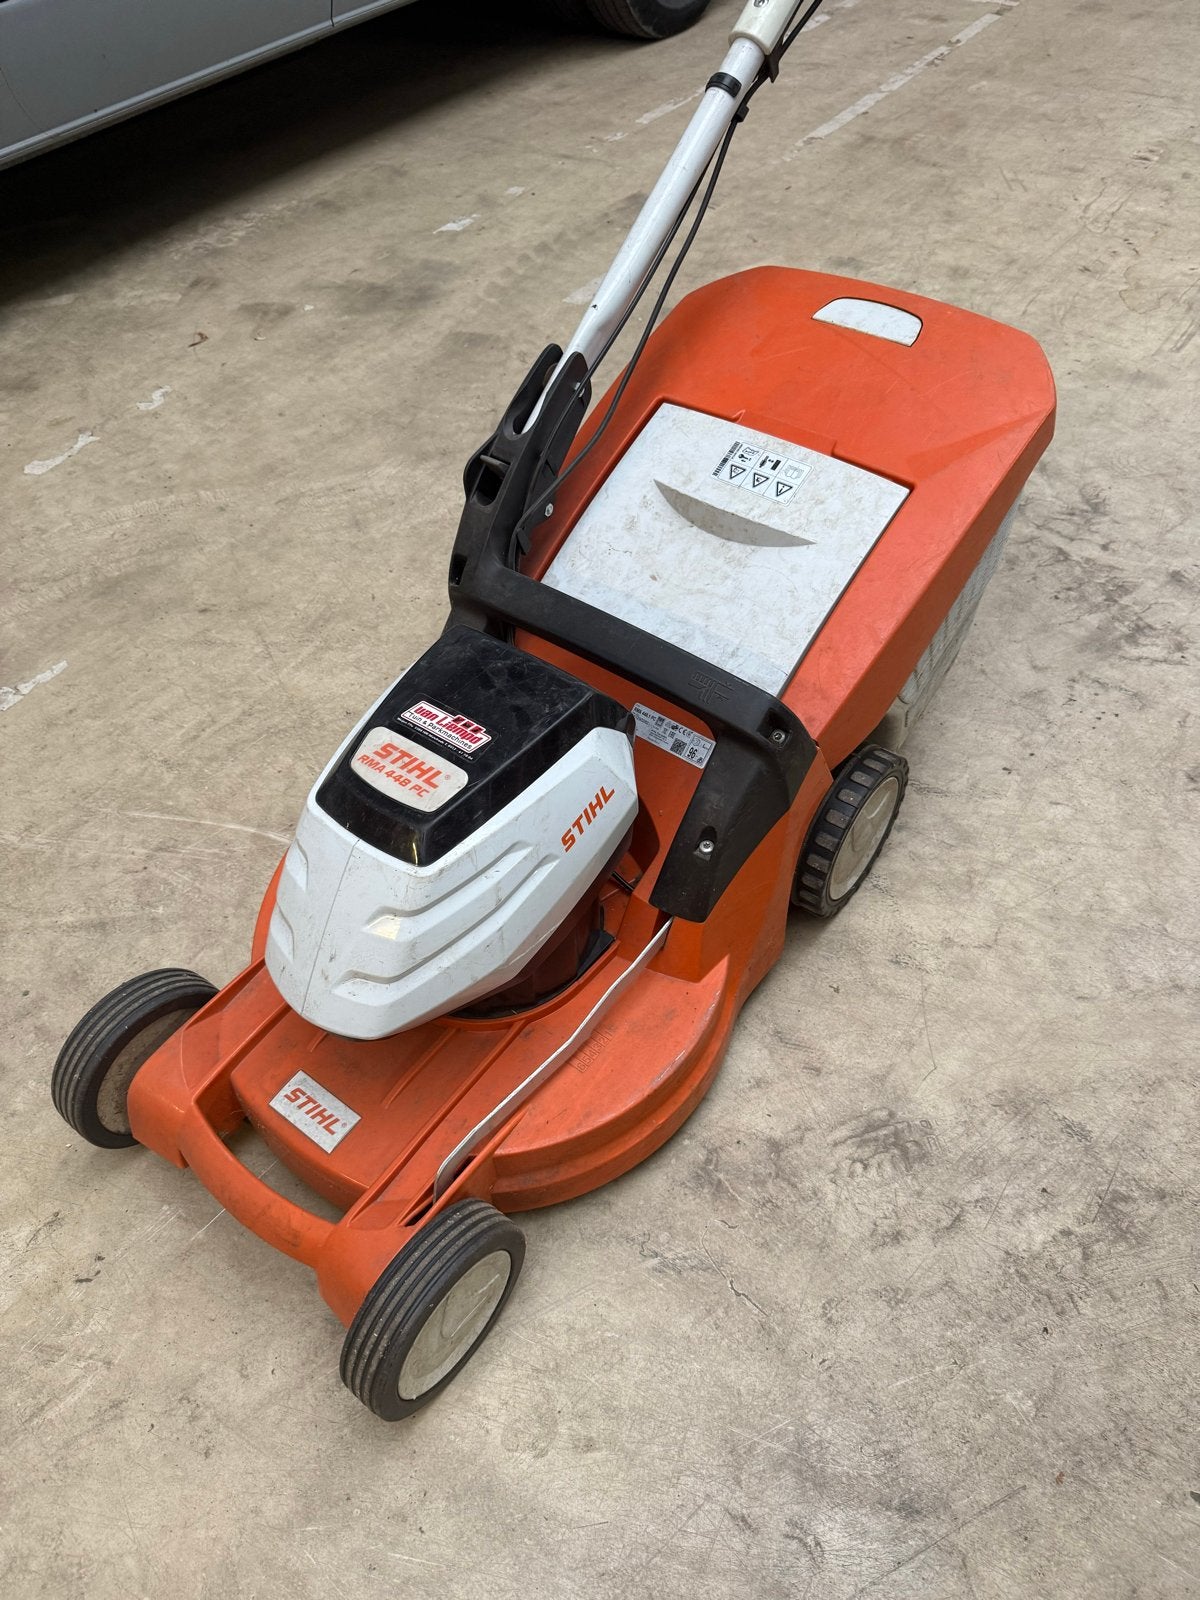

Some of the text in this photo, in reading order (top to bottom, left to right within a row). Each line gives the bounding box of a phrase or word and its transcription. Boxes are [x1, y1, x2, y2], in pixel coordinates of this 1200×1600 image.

[408, 711, 422, 724] Tuin
[427, 722, 473, 750] Parkmachines
[413, 705, 438, 721] van
[436, 716, 483, 744] Liempd
[373, 742, 443, 790] STIHL
[687, 747, 698, 759] 96
[357, 754, 430, 798] RMA 448 PC
[561, 785, 616, 853] STIHL
[283, 1087, 341, 1136] STIHL
